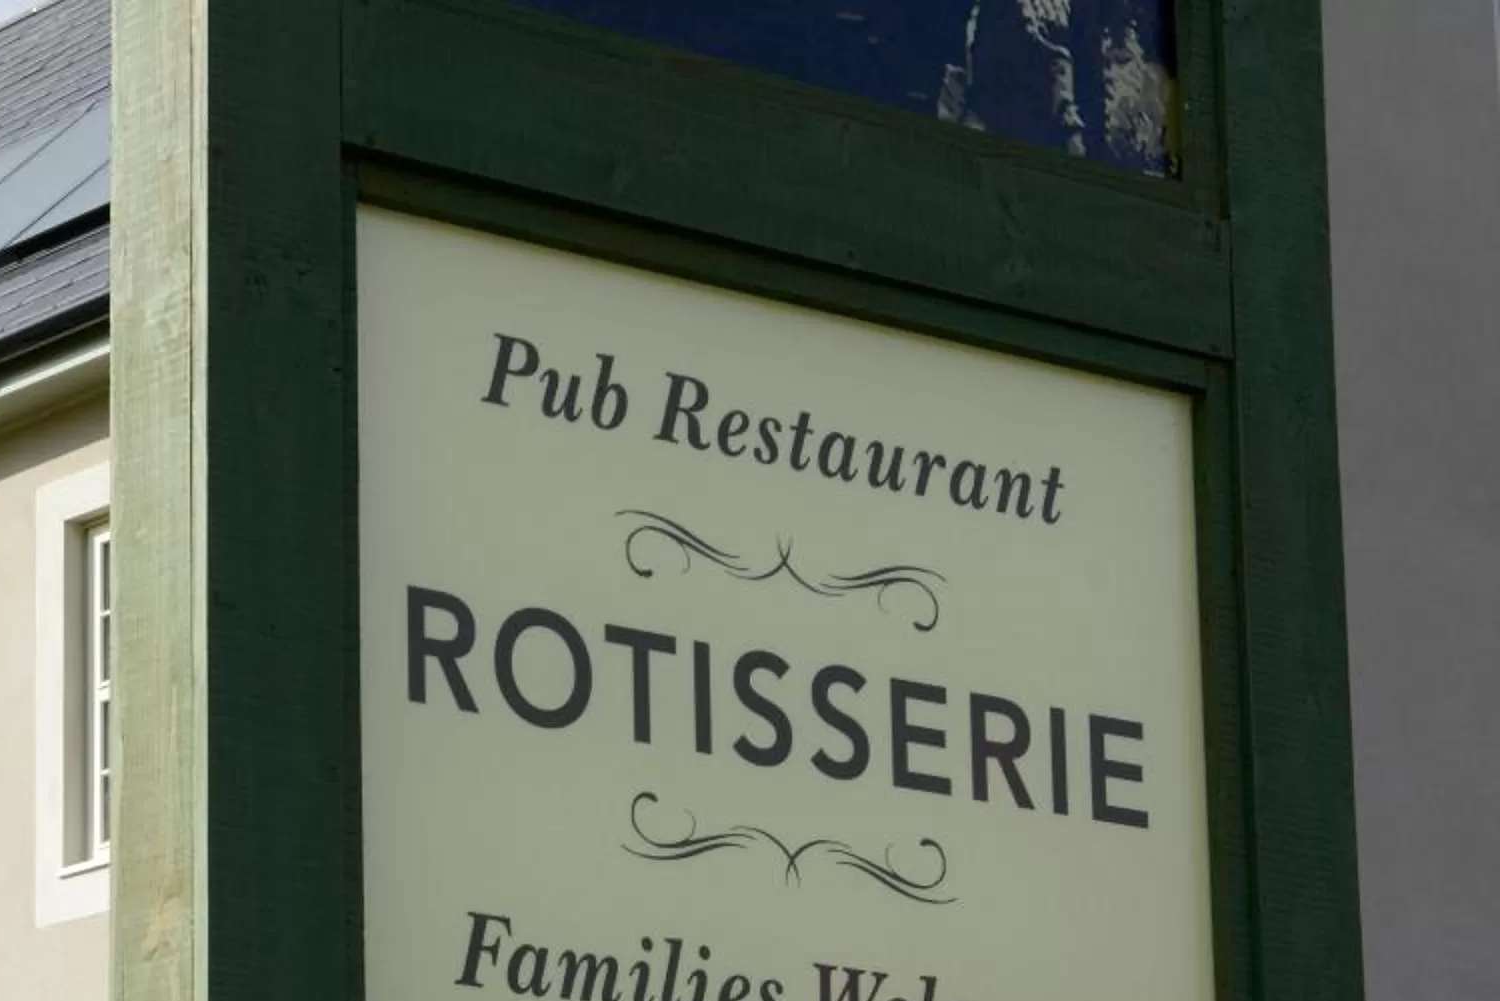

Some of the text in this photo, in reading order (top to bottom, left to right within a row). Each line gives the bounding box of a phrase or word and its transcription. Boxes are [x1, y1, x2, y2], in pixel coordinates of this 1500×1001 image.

[480, 332, 1066, 525] Pub Restaurant
[405, 584, 1151, 830] ROTISSERIE
